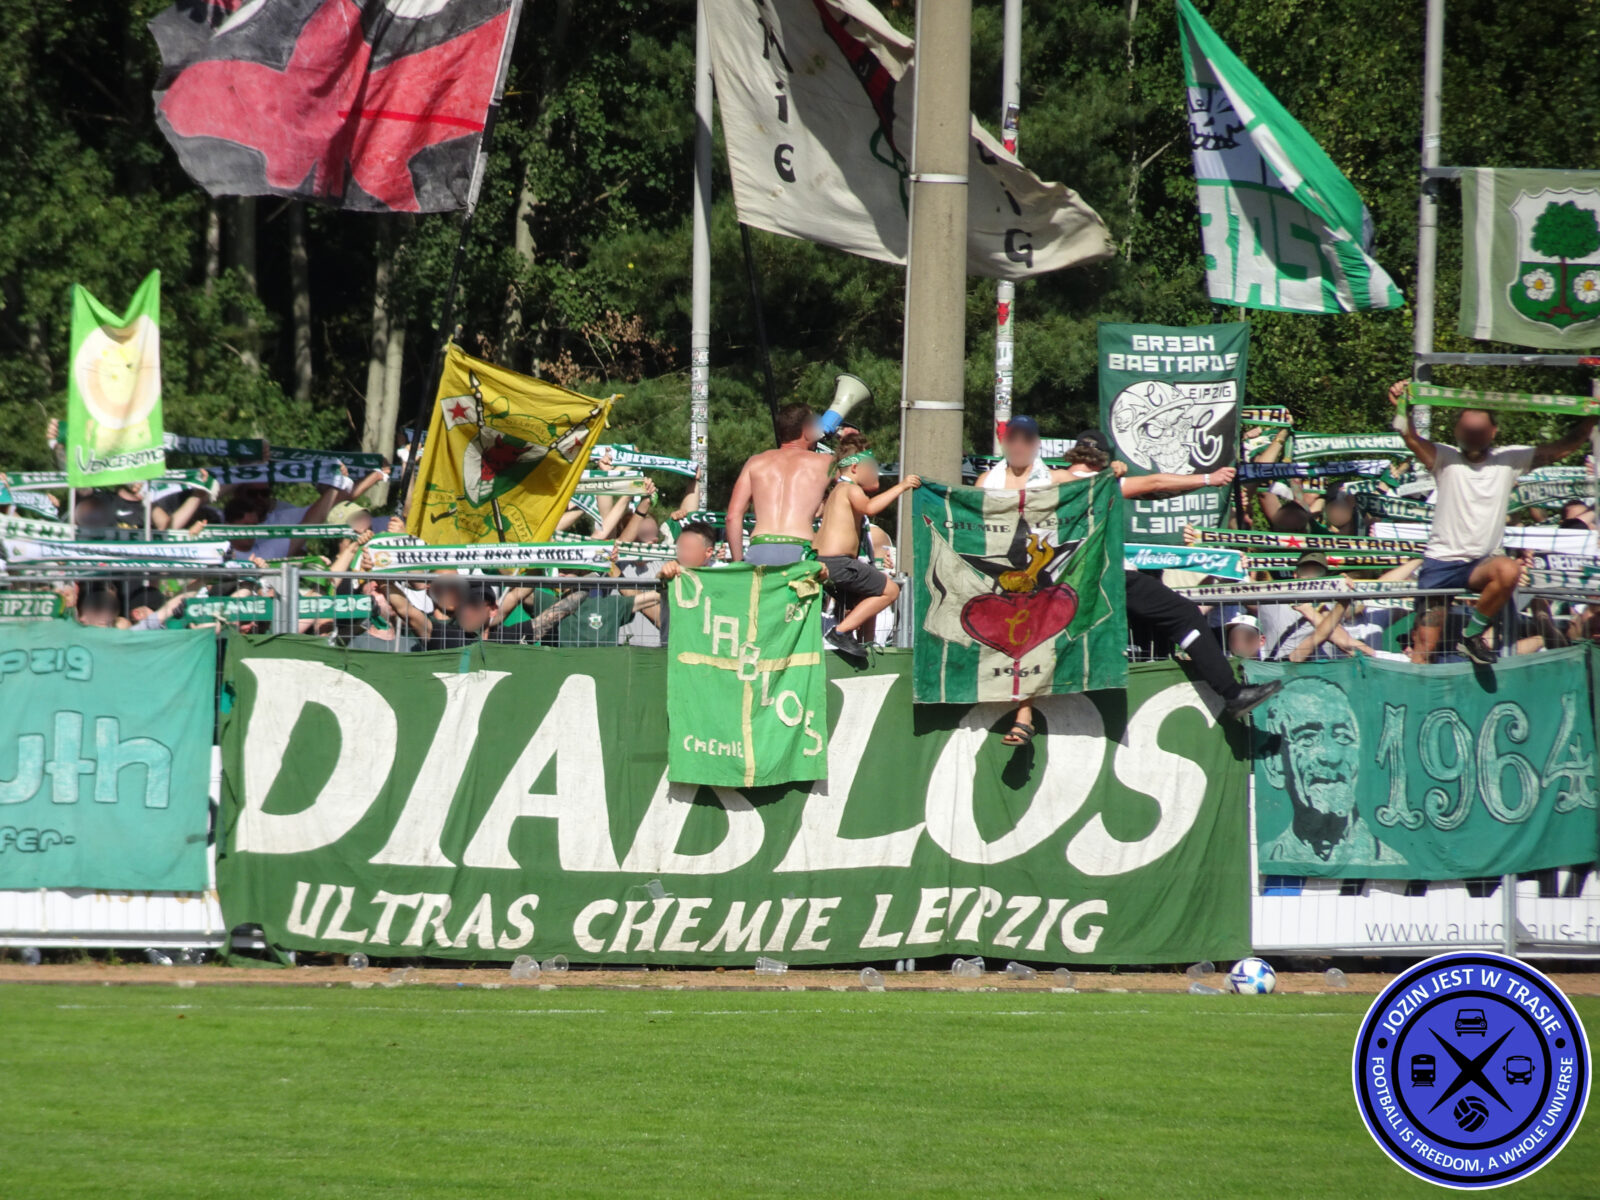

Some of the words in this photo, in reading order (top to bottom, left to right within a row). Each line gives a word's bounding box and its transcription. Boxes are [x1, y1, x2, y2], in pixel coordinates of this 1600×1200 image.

[1419, 386, 1578, 406] DIABLOS
[0, 600, 55, 616] IPZIG
[298, 596, 372, 614] EIPZIG
[991, 664, 1043, 678] 1964
[683, 734, 745, 758] CHEMIE
[1375, 691, 1599, 832] 1964
[286, 881, 540, 950] ULTRAS
[573, 896, 842, 954] CHEMIE
[859, 885, 1109, 954] LEIPZIG
